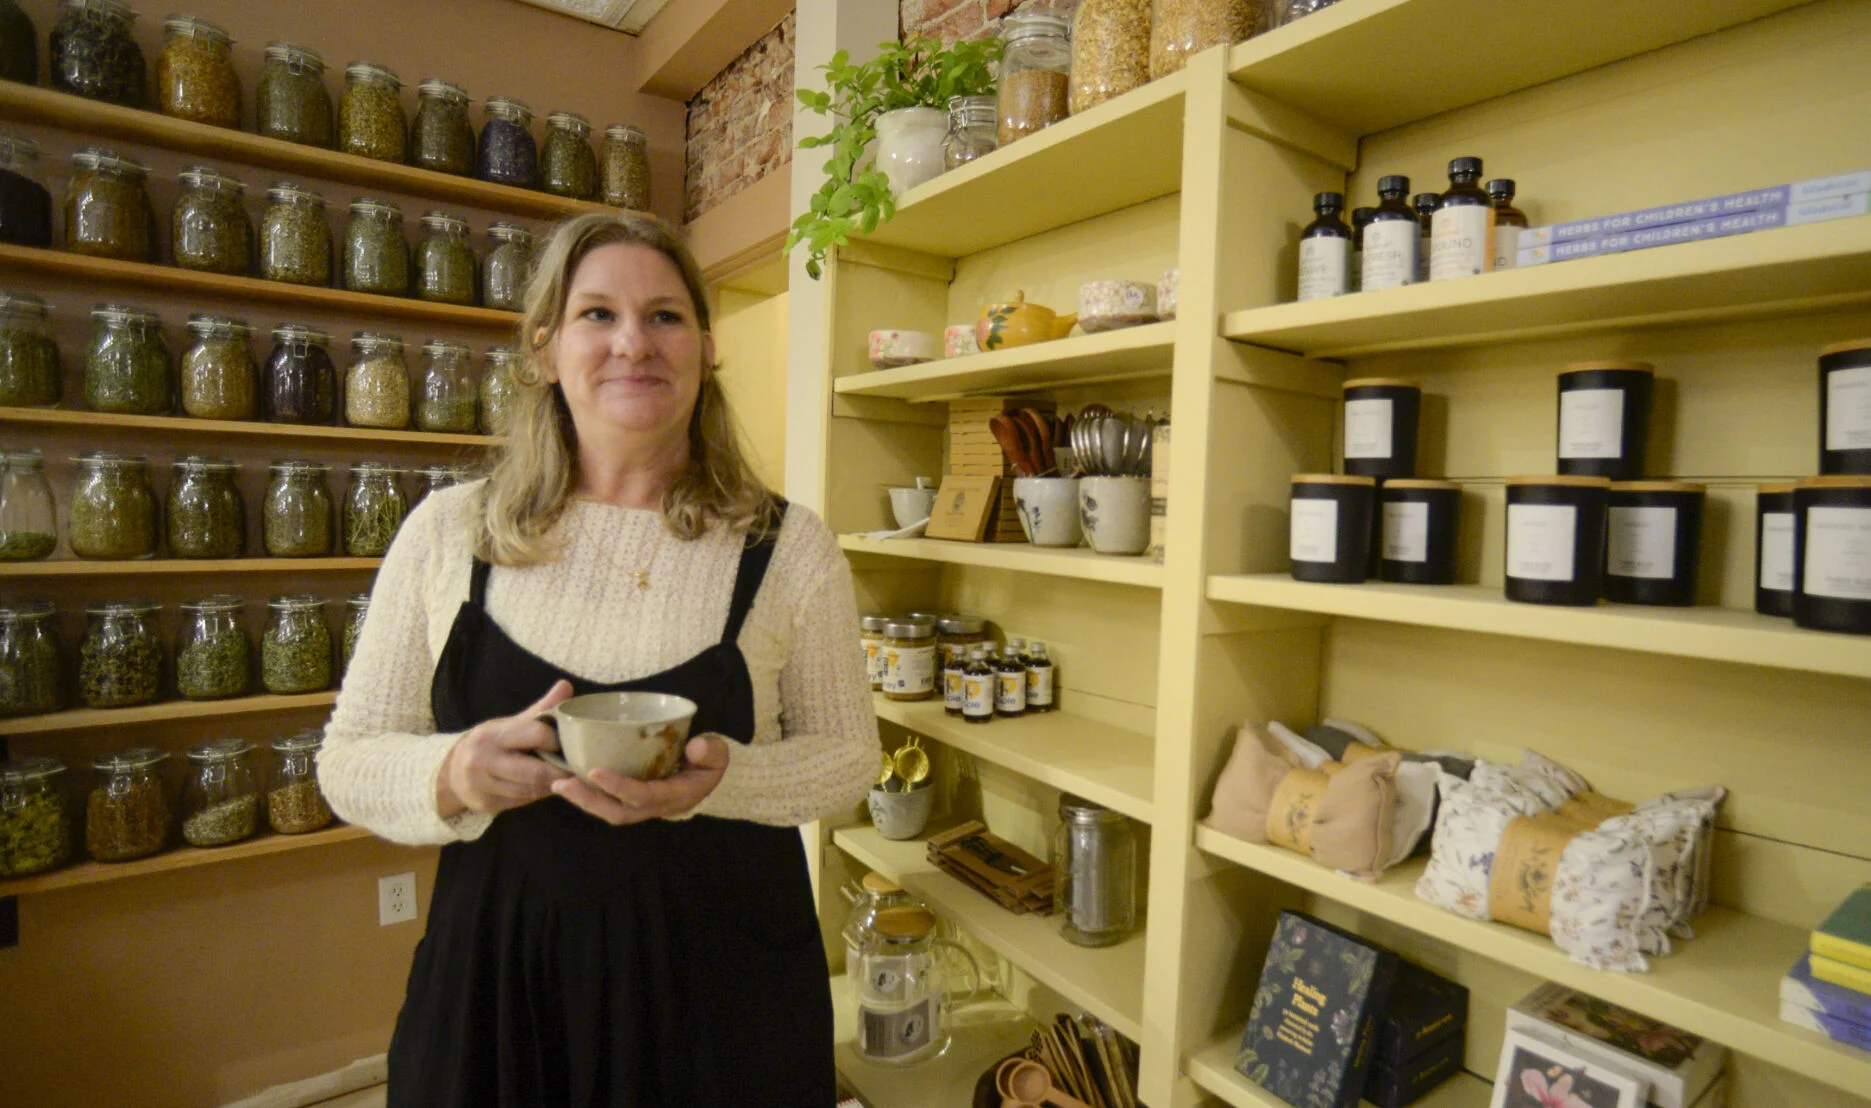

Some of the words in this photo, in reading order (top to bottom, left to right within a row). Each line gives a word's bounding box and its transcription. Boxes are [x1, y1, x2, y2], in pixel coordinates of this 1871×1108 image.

[1556, 241, 1597, 257] HERBS
[1601, 236, 1629, 249] FOR
[1633, 222, 1716, 245] CHILDREN'S
[1720, 213, 1778, 231] HEALTH
[1558, 222, 1599, 237] HERBS
[1603, 216, 1632, 229] FOR
[1635, 201, 1719, 225] CHILDREN'S
[1723, 191, 1783, 209] HEALTH
